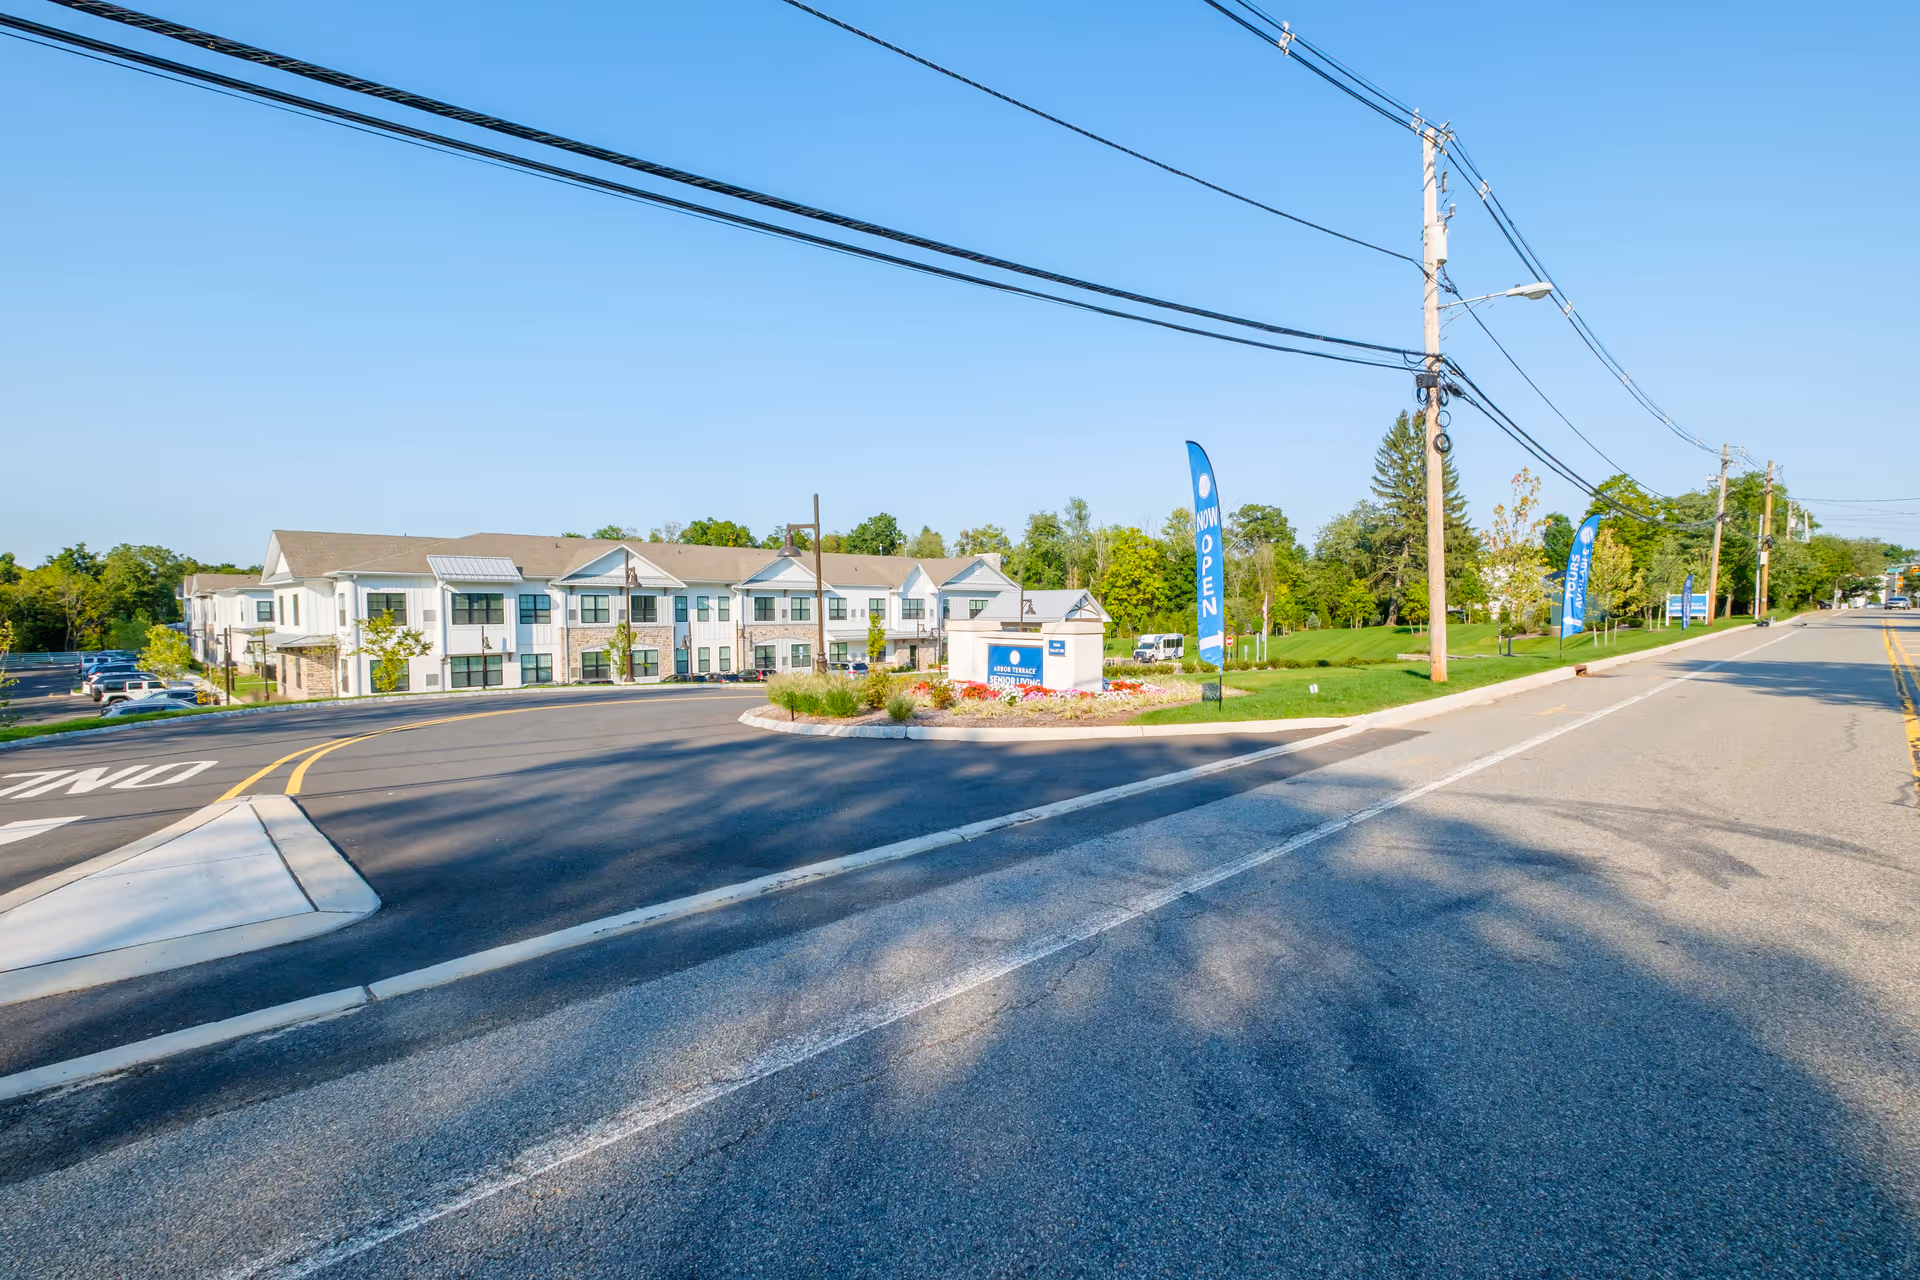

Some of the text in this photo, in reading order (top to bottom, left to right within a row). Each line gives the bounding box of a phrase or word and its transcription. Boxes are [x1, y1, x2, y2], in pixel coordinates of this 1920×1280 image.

[1196, 505, 1218, 533] NOW
[1201, 534, 1218, 618] OPEN
[1565, 554, 1581, 600] TOURS
[989, 675, 1041, 686] SENIOR LIVING
[993, 665, 1036, 675] ARBOR TERRACE
